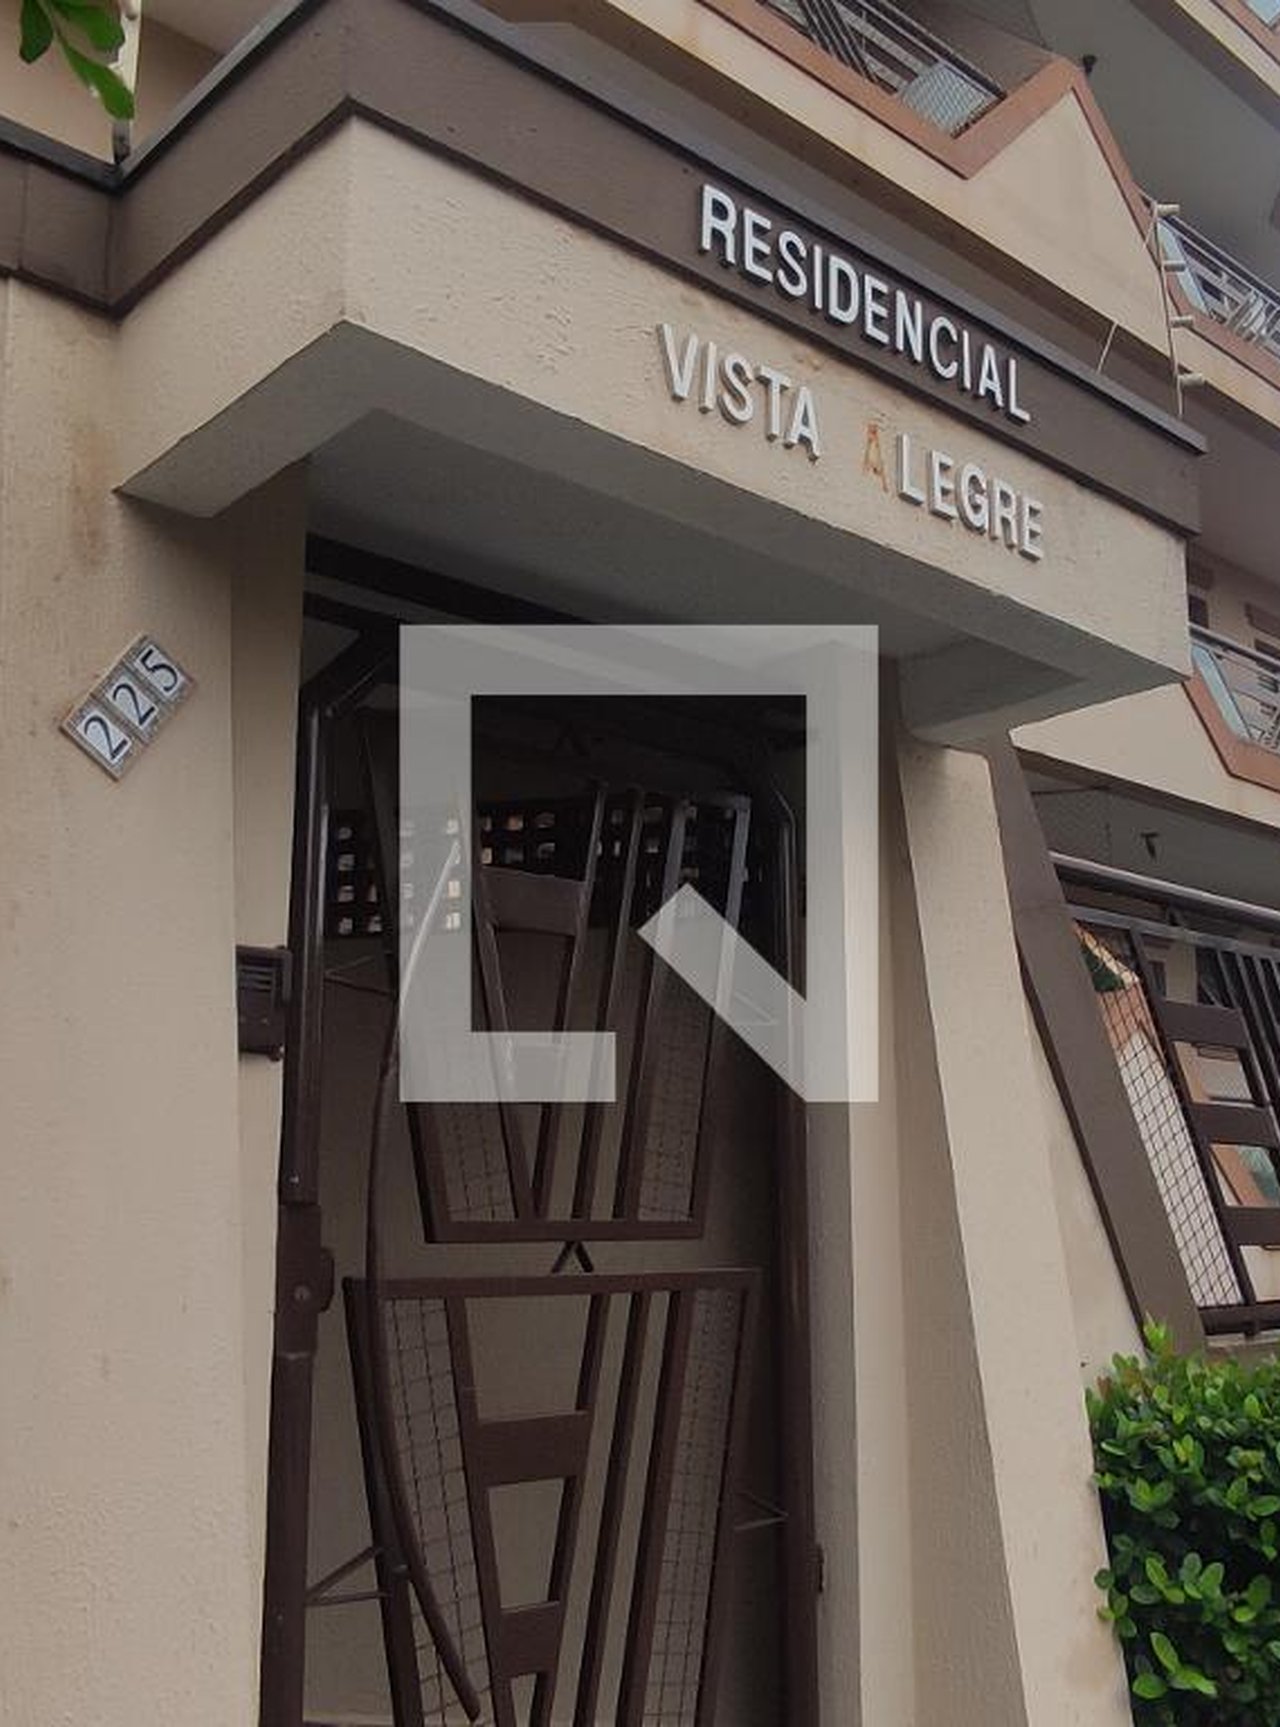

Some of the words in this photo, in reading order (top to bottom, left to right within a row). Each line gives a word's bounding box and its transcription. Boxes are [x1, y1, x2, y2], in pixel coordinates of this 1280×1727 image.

[700, 184, 1031, 422] RESIDENCIAL
[658, 323, 821, 463] VISTA
[863, 422, 1044, 562] ALEGRE
[83, 647, 178, 760] 225
